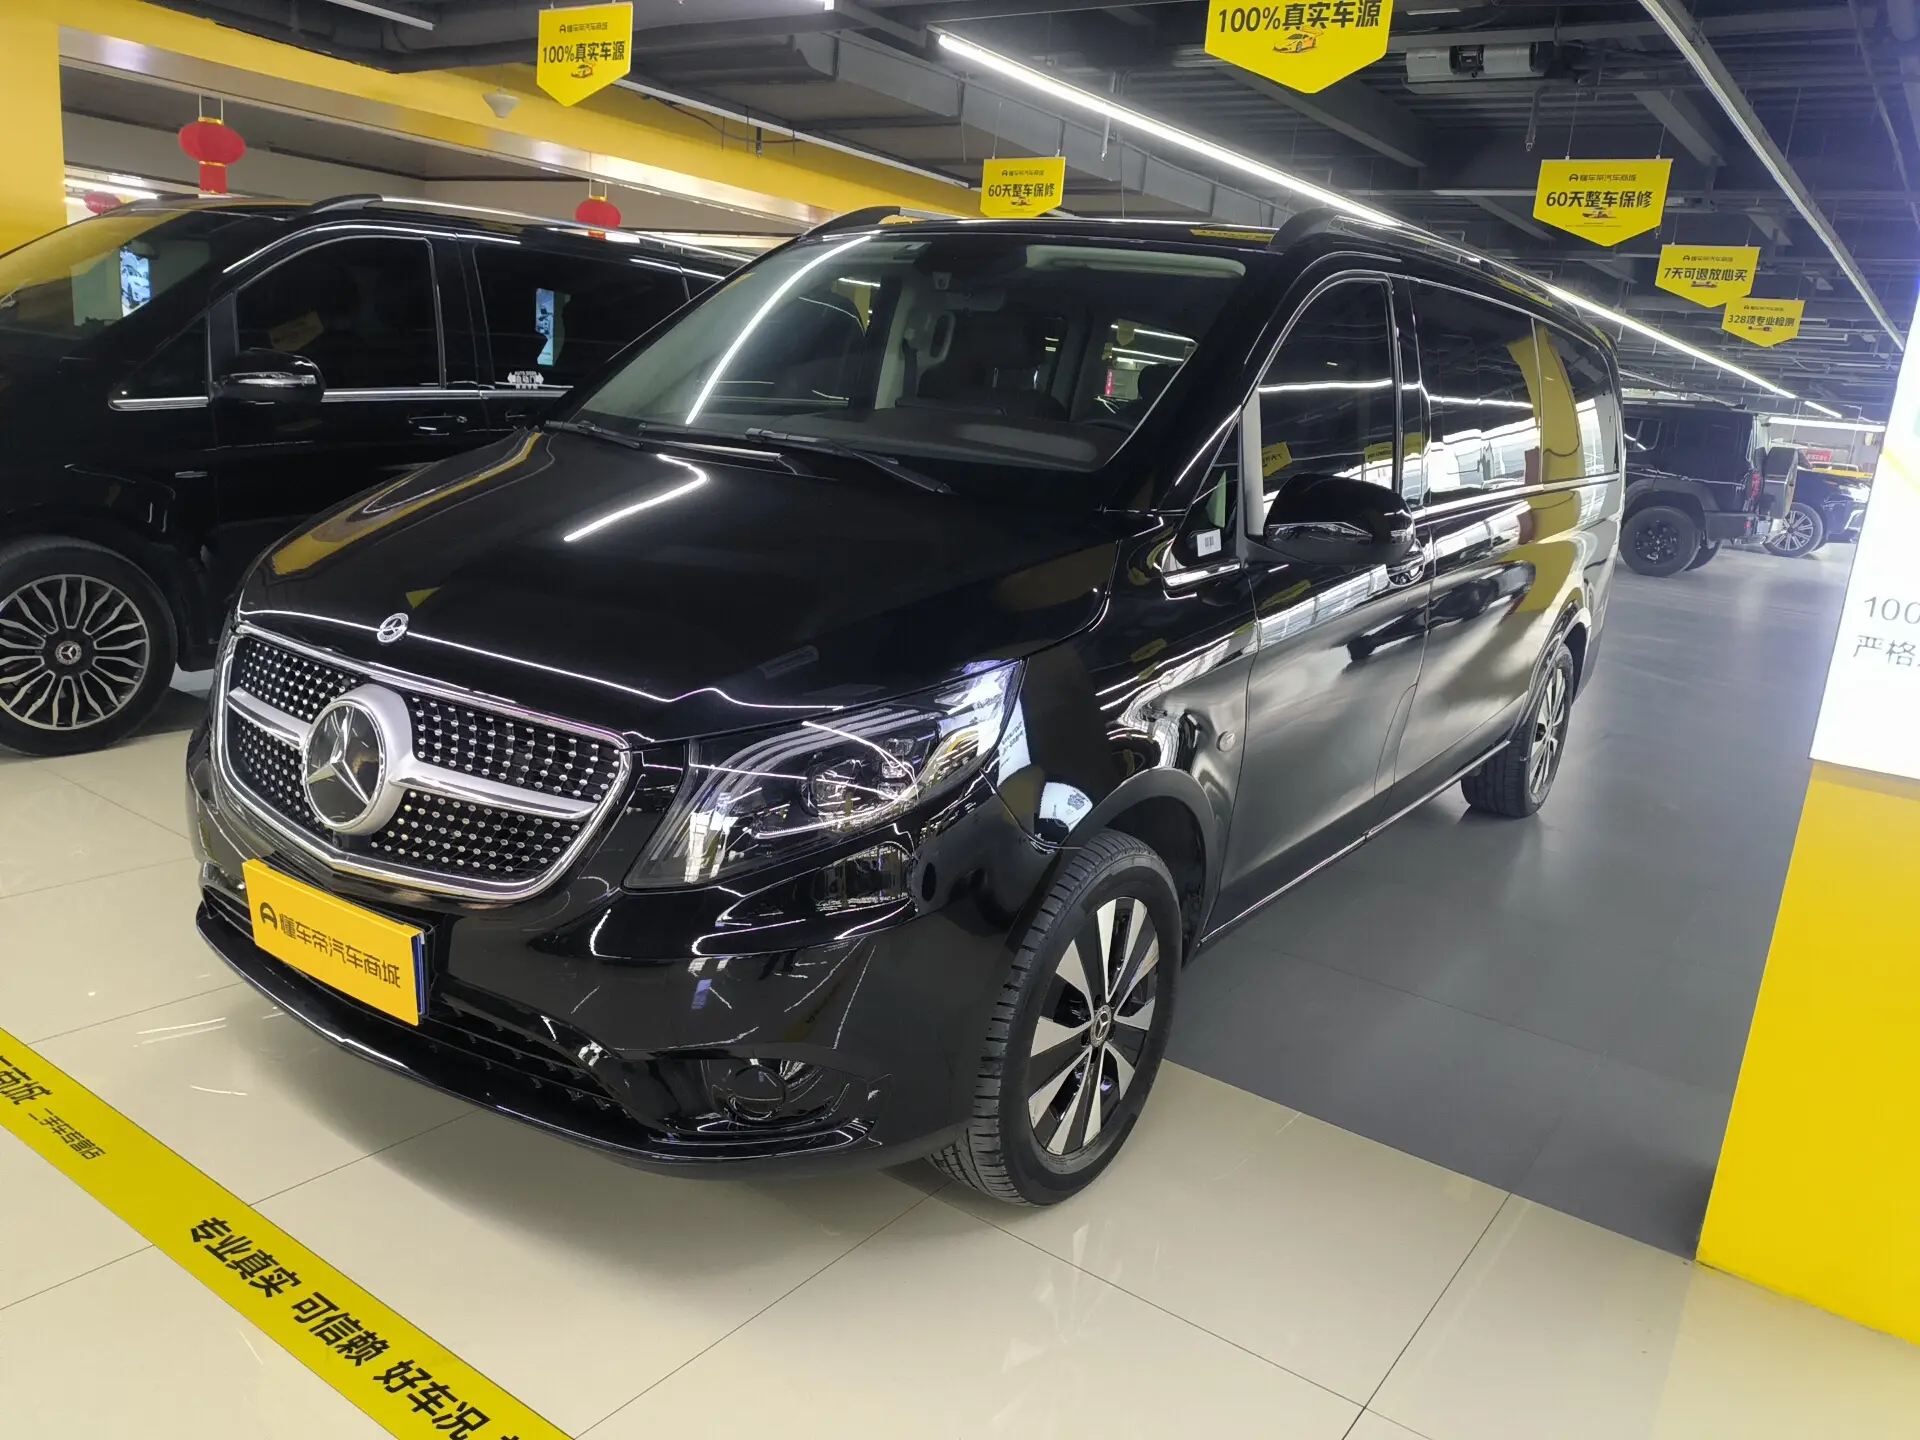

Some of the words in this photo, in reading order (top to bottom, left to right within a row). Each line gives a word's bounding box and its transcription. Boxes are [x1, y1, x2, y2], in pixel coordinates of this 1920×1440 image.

[1219, 0, 1382, 33] 100%真实车源
[543, 41, 625, 63] 100%真实车源
[988, 183, 1055, 197] 60天整车保修
[1546, 190, 1653, 208] 60天整车保修
[1664, 267, 1748, 282] 7天可退放心买
[1728, 314, 1795, 327] 328项专业检测
[1853, 635, 1920, 667] 严格
[280, 913, 401, 988] 懂车帝汽车商城
[0, 1055, 53, 1105] 商城
[28, 1107, 107, 1160] 二手车专营店
[190, 1217, 302, 1298] 专业真实
[291, 1291, 391, 1367] 可信赖
[373, 1359, 492, 1440] 好车况
